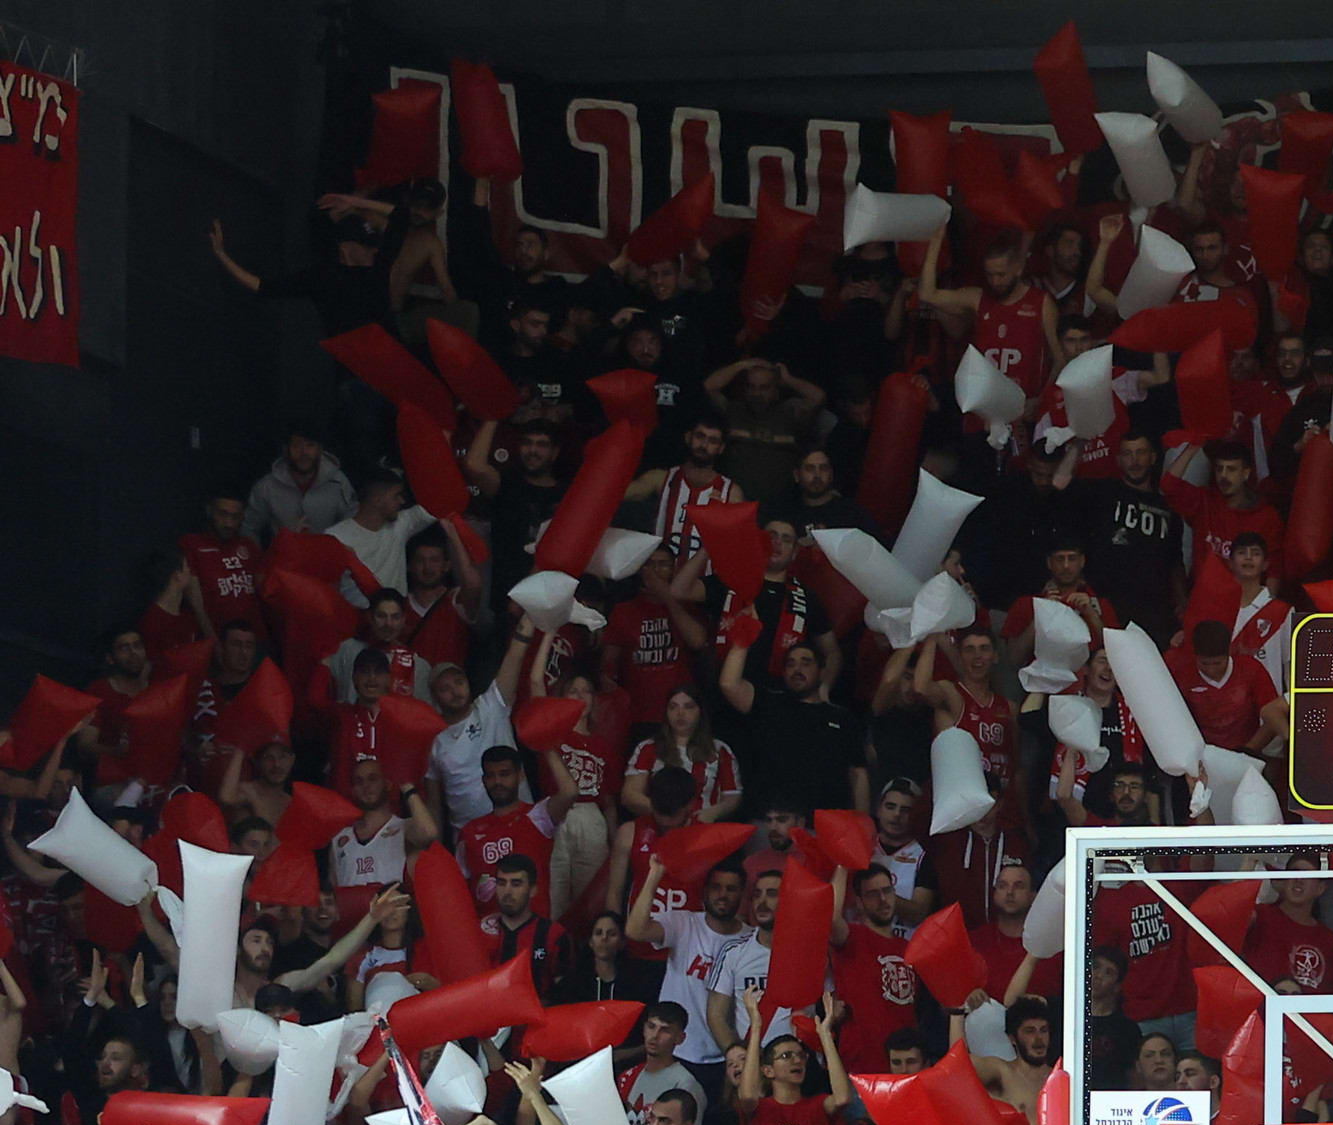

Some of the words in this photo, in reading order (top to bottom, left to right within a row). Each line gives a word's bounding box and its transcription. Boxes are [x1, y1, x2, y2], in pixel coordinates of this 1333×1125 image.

[483, 837, 514, 864] 69
[357, 857, 375, 875] 12
[1111, 1108, 1133, 1119] איגוד
